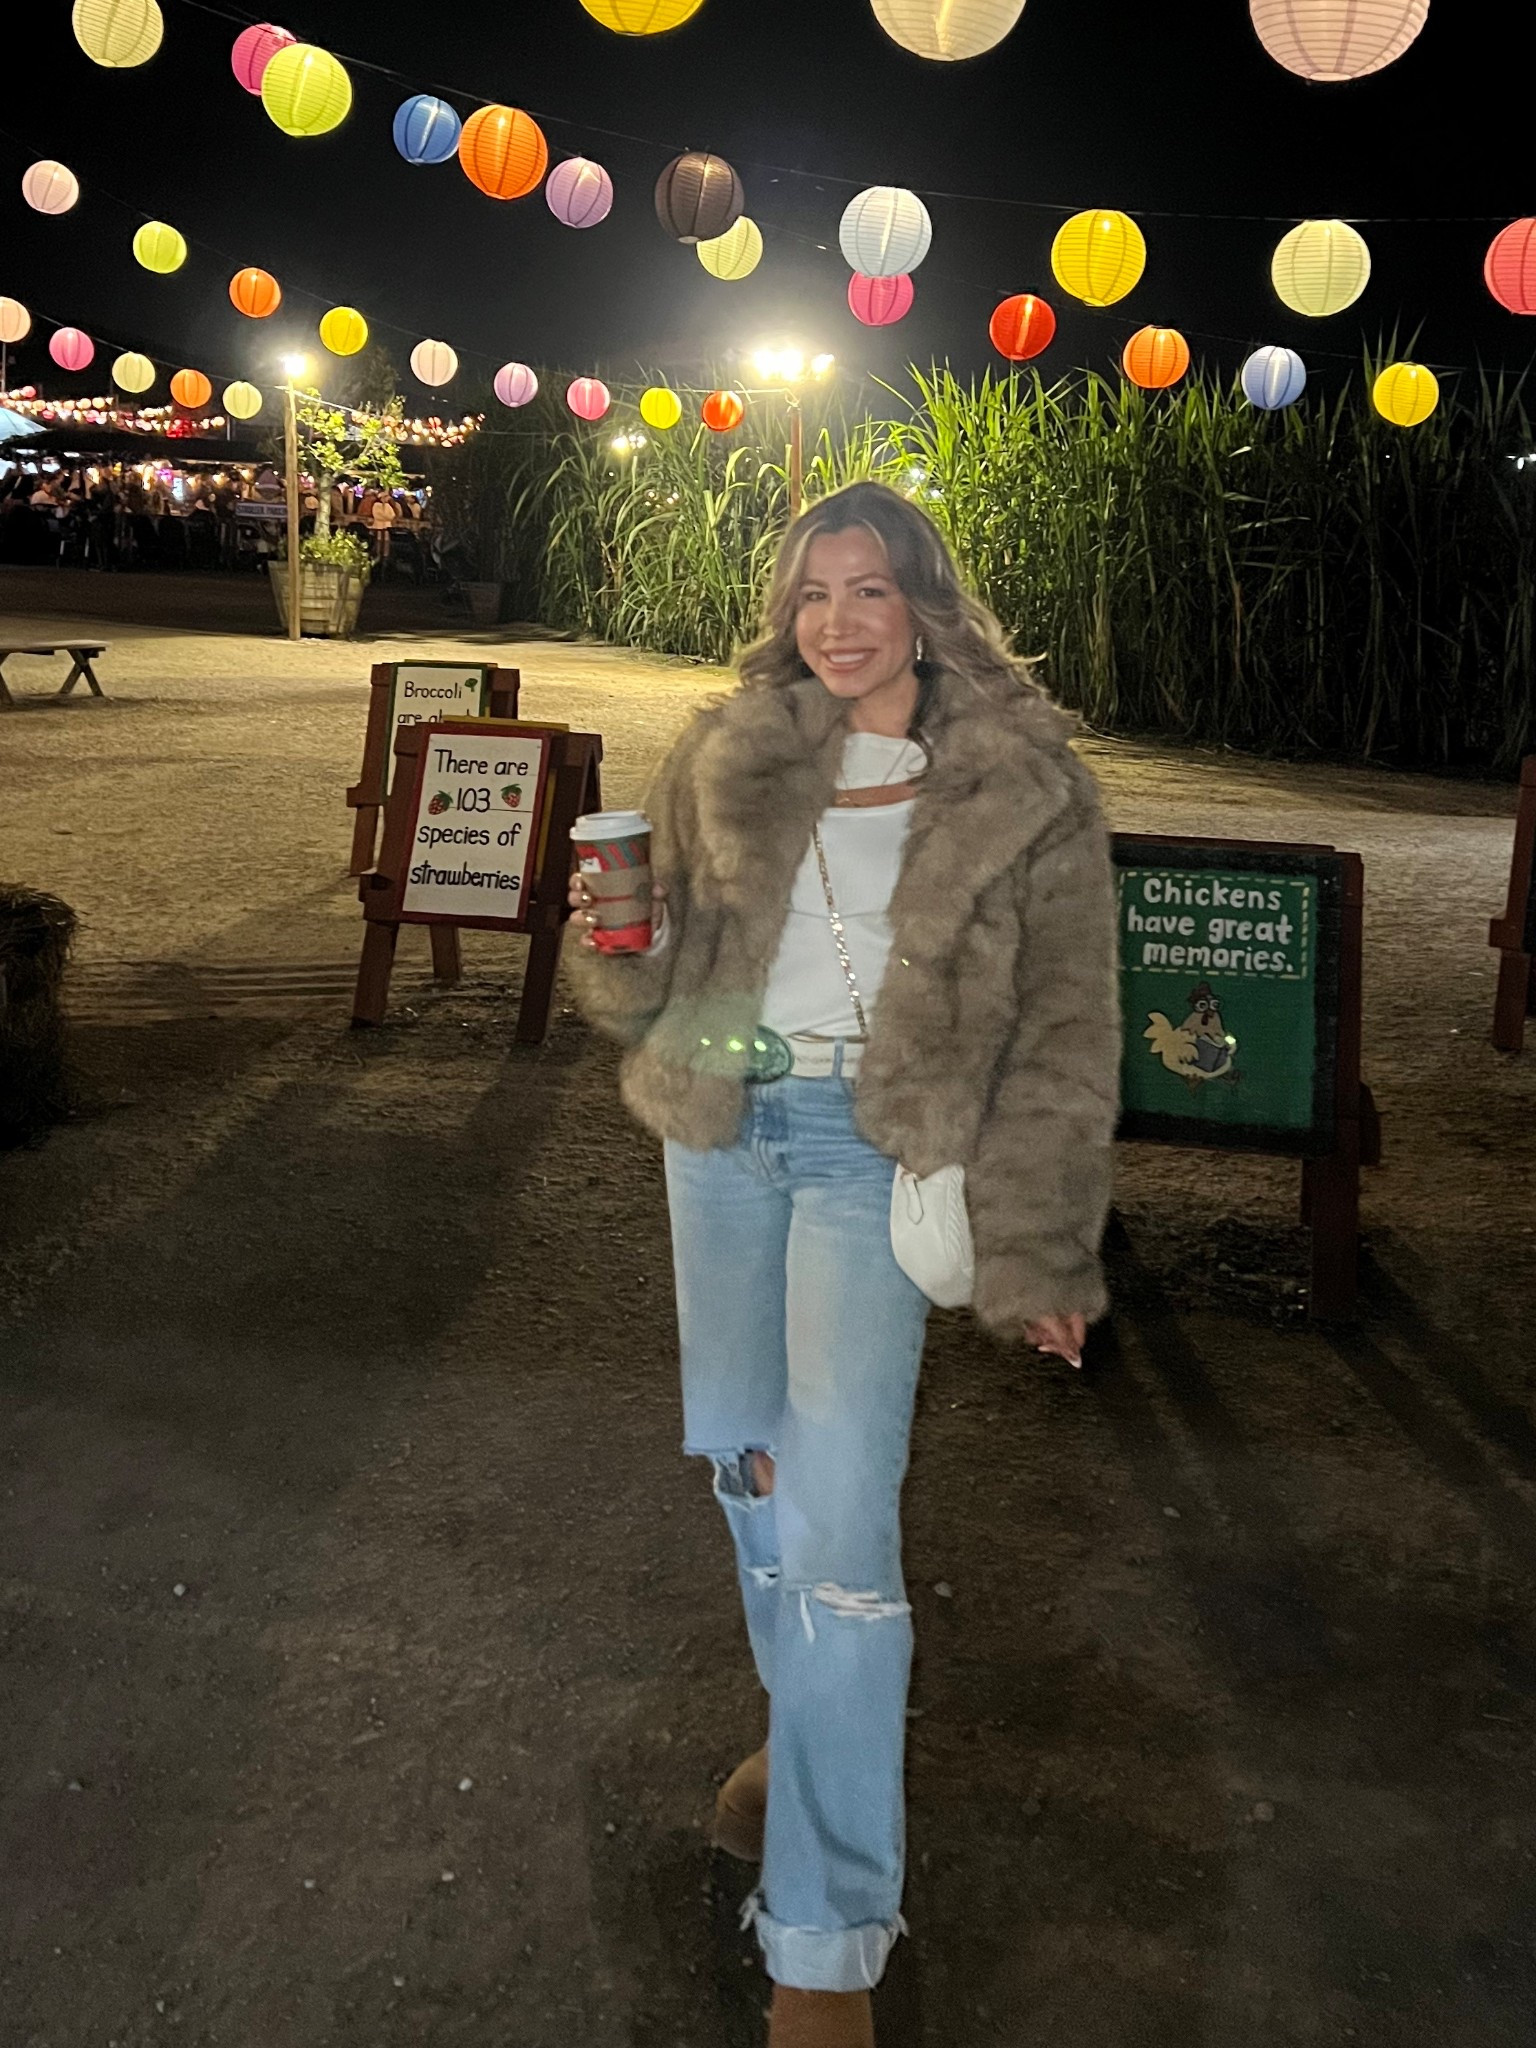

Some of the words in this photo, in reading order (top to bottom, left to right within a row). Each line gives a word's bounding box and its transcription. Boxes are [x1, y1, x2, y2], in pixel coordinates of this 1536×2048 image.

[404, 681, 462, 699] Broccoli
[434, 749, 488, 776] There
[494, 758, 529, 776] are
[456, 787, 491, 813] 103
[417, 825, 490, 848] species
[497, 823, 522, 847] of
[409, 860, 521, 891] strawberries
[1143, 877, 1282, 911] Chickens
[1127, 905, 1195, 936] have
[1208, 914, 1293, 945] great
[1142, 942, 1294, 972] memories.
